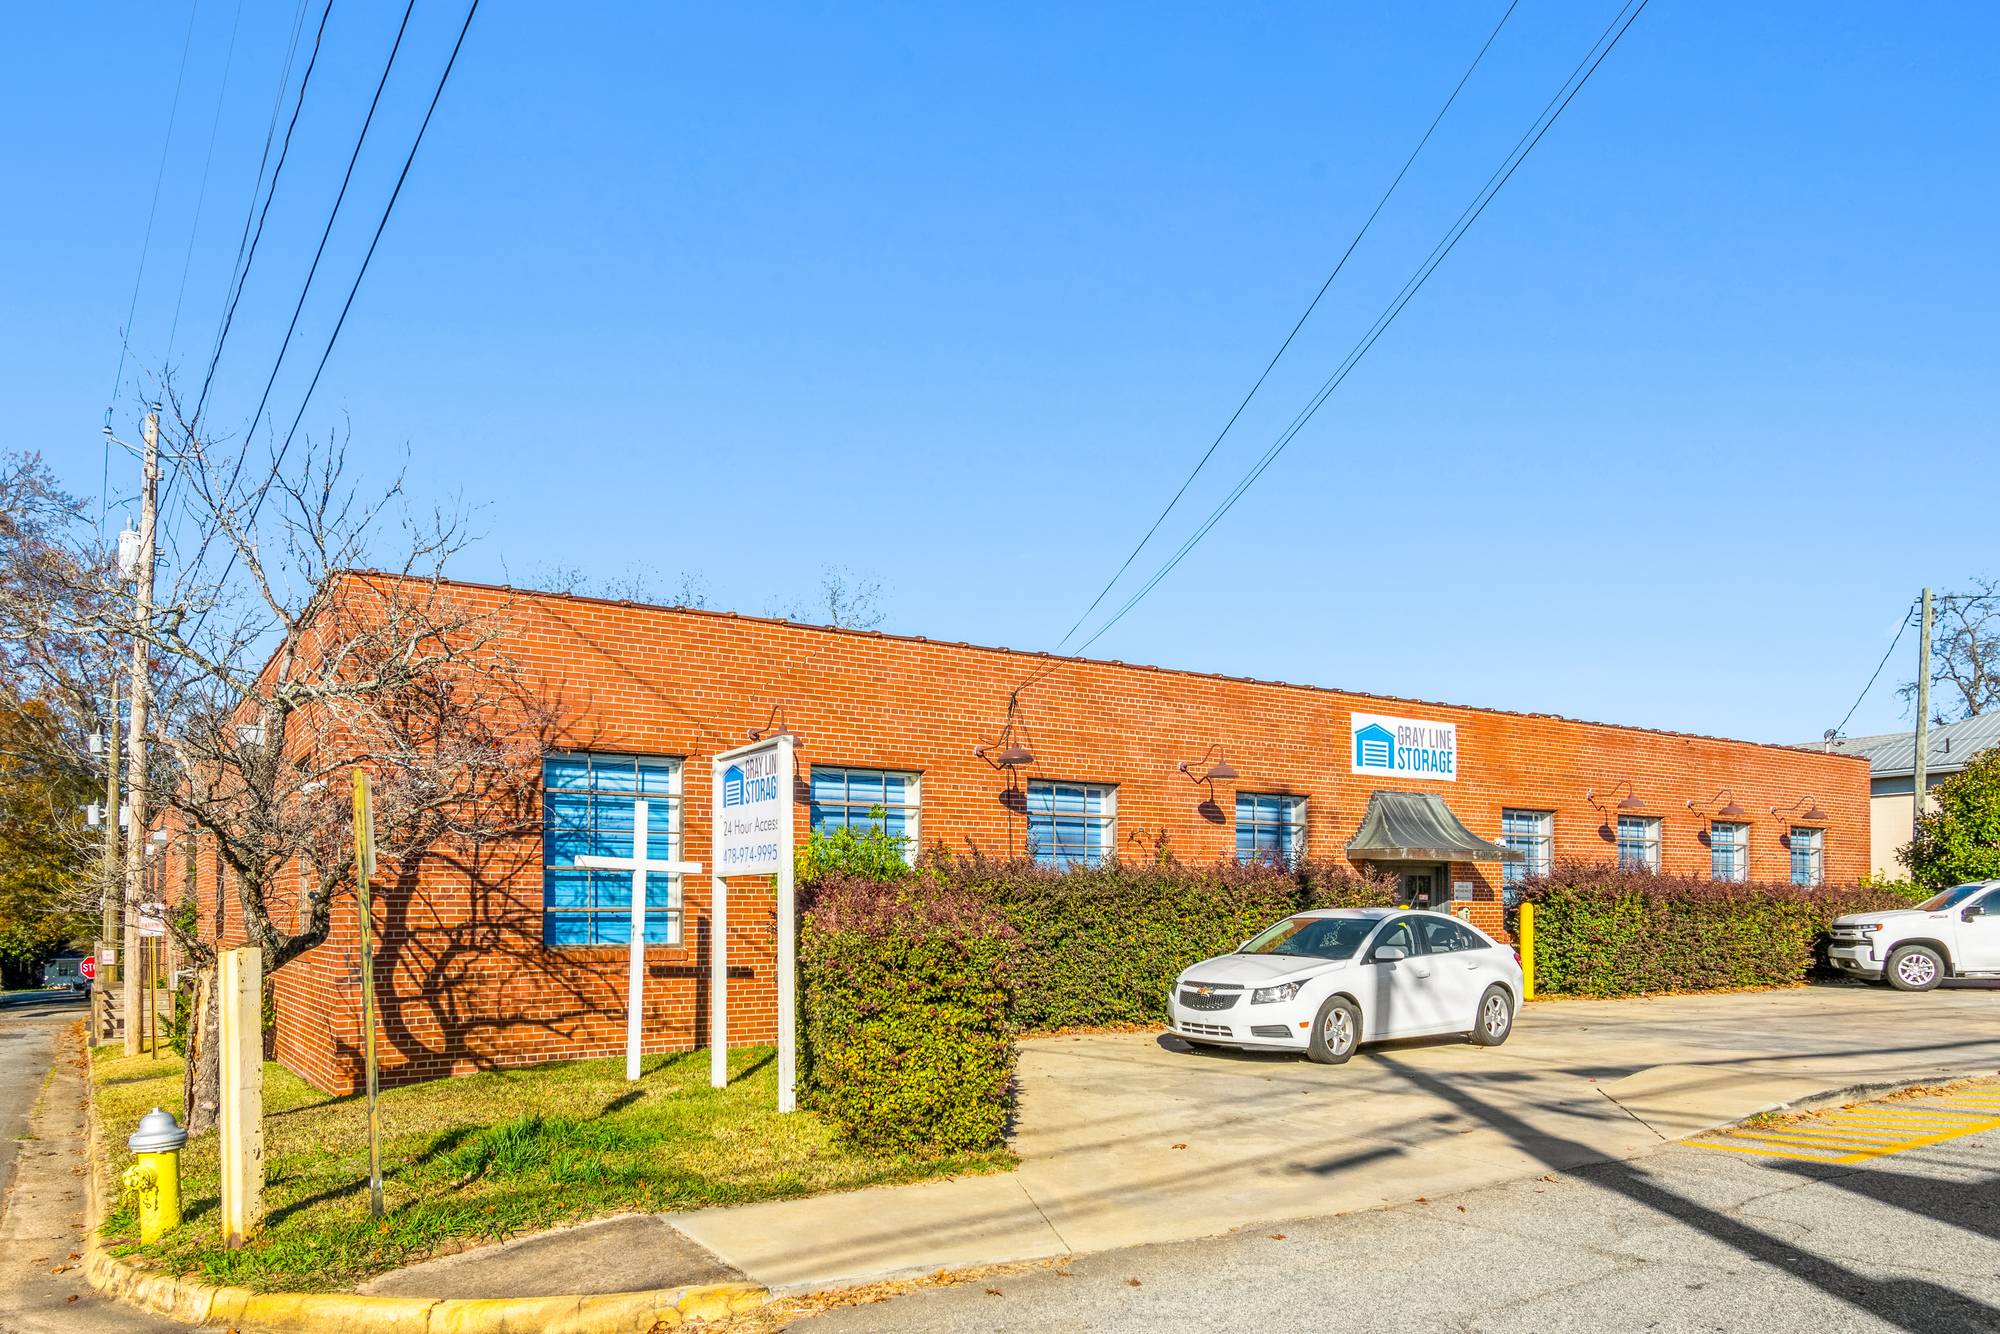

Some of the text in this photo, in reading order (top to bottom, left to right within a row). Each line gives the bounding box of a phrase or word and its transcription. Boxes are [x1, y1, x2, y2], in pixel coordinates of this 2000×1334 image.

[1397, 725, 1452, 750] GRAY LINE
[745, 752, 778, 780] GRAY LIN
[1397, 746, 1453, 773] STORAGE
[745, 775, 778, 804] STORAG
[723, 821, 732, 836] 24
[735, 819, 752, 834] Hour
[723, 843, 778, 864] 478-974-9995
[82, 963, 95, 973] ST
